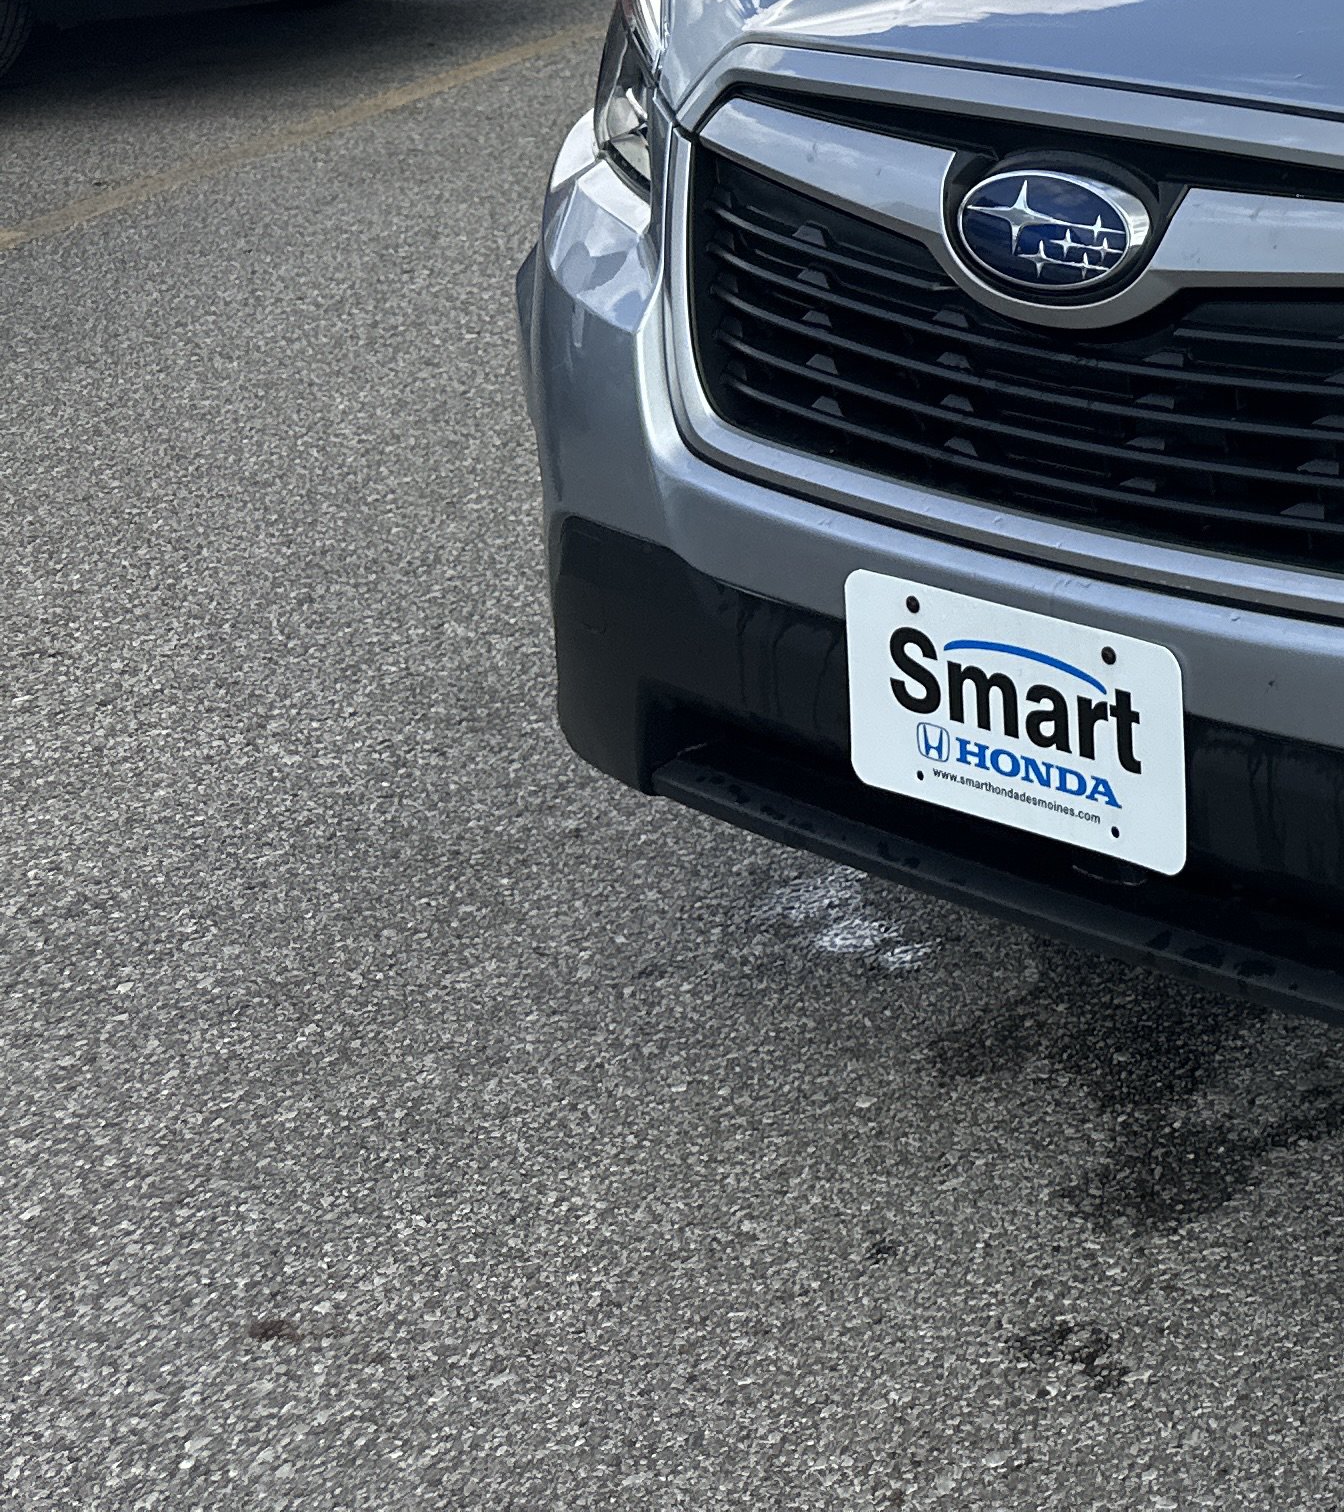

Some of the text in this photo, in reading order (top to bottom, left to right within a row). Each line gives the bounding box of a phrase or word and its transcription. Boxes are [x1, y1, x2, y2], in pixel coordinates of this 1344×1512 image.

[889, 626, 1142, 775] Smart
[933, 767, 1101, 824] www.smarthondadesmoines.com
[955, 737, 1122, 809] HONDA
